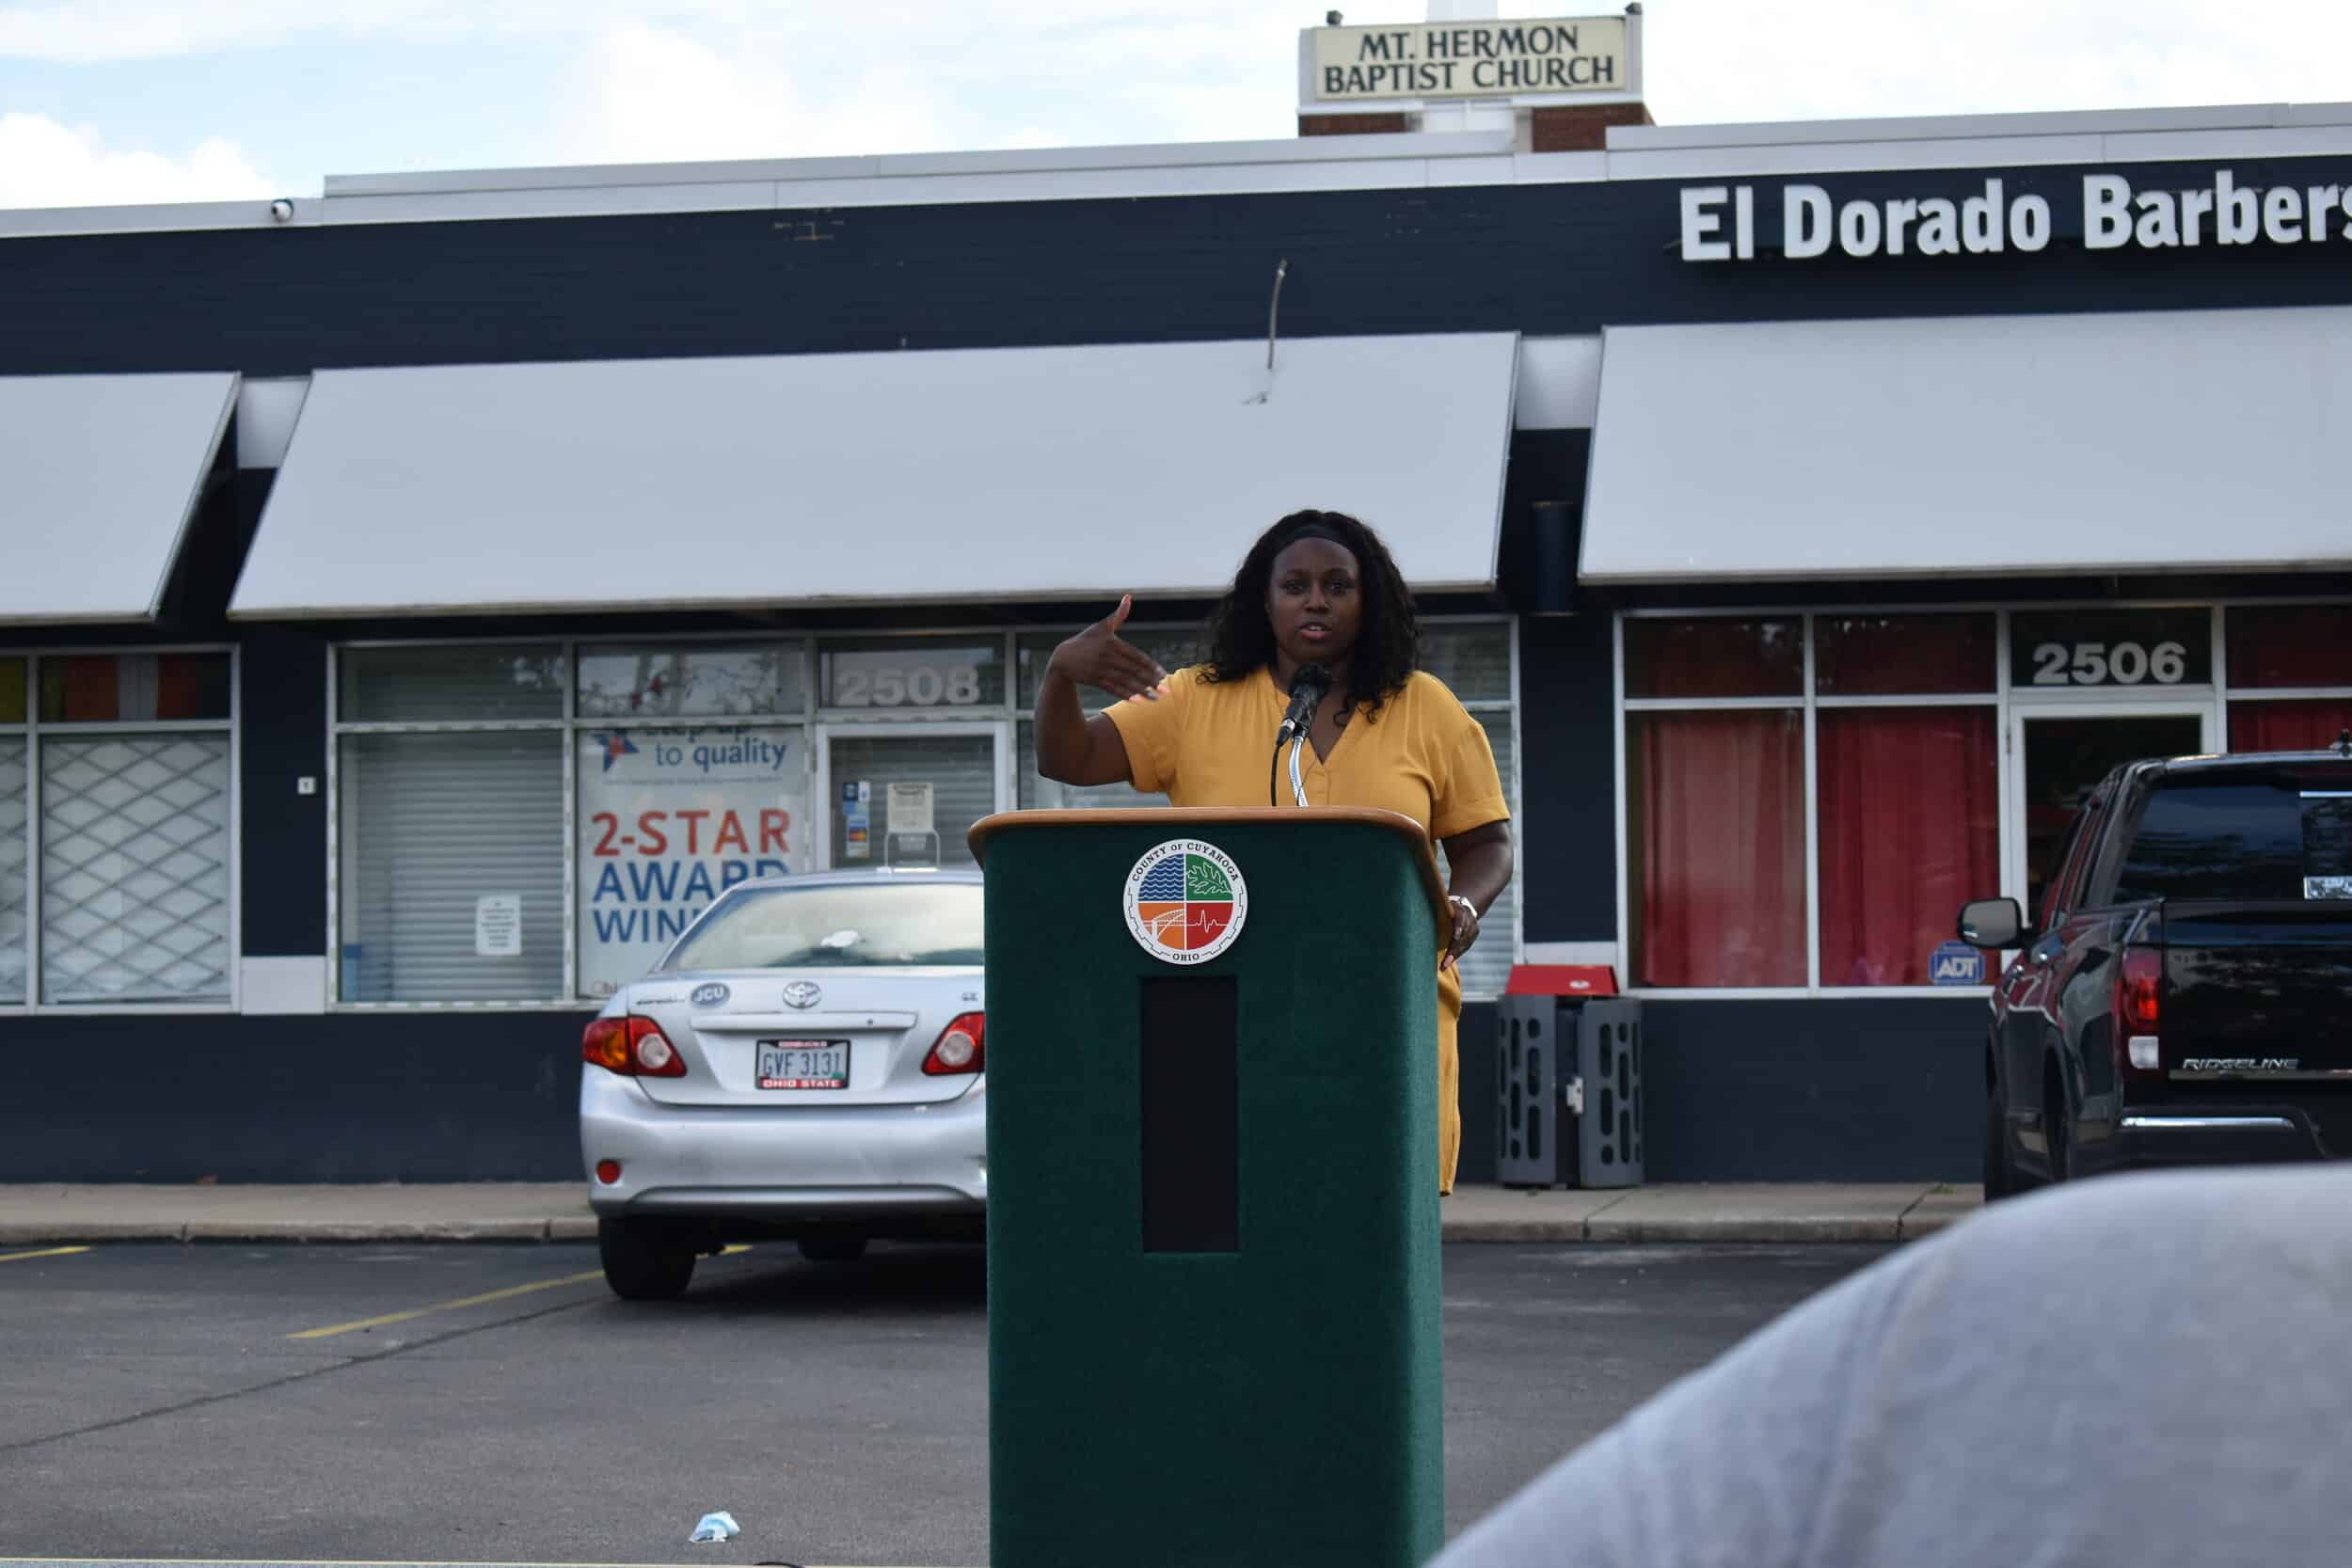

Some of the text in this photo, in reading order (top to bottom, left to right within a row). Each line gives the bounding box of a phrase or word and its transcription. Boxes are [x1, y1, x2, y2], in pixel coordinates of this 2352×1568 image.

[1359, 26, 1579, 61] MT. HERMON
[1324, 56, 1613, 93] BAPTIST CHURCH
[1680, 185, 1753, 261] El
[1783, 178, 2051, 258] Dorado
[2032, 641, 2186, 685] 2506
[836, 667, 980, 706] 2508
[655, 736, 787, 773] to quality
[591, 808, 791, 857] 2-STAR
[1132, 846, 1167, 881] COUNTY
[1186, 842, 1239, 882] CUYAHOGA
[592, 908, 702, 943] WIN
[1937, 957, 1978, 978] ADT
[694, 986, 724, 1002] JCU
[2183, 1058, 2299, 1070] RIDGELINE
[762, 1079, 841, 1088] OHIO STATE
